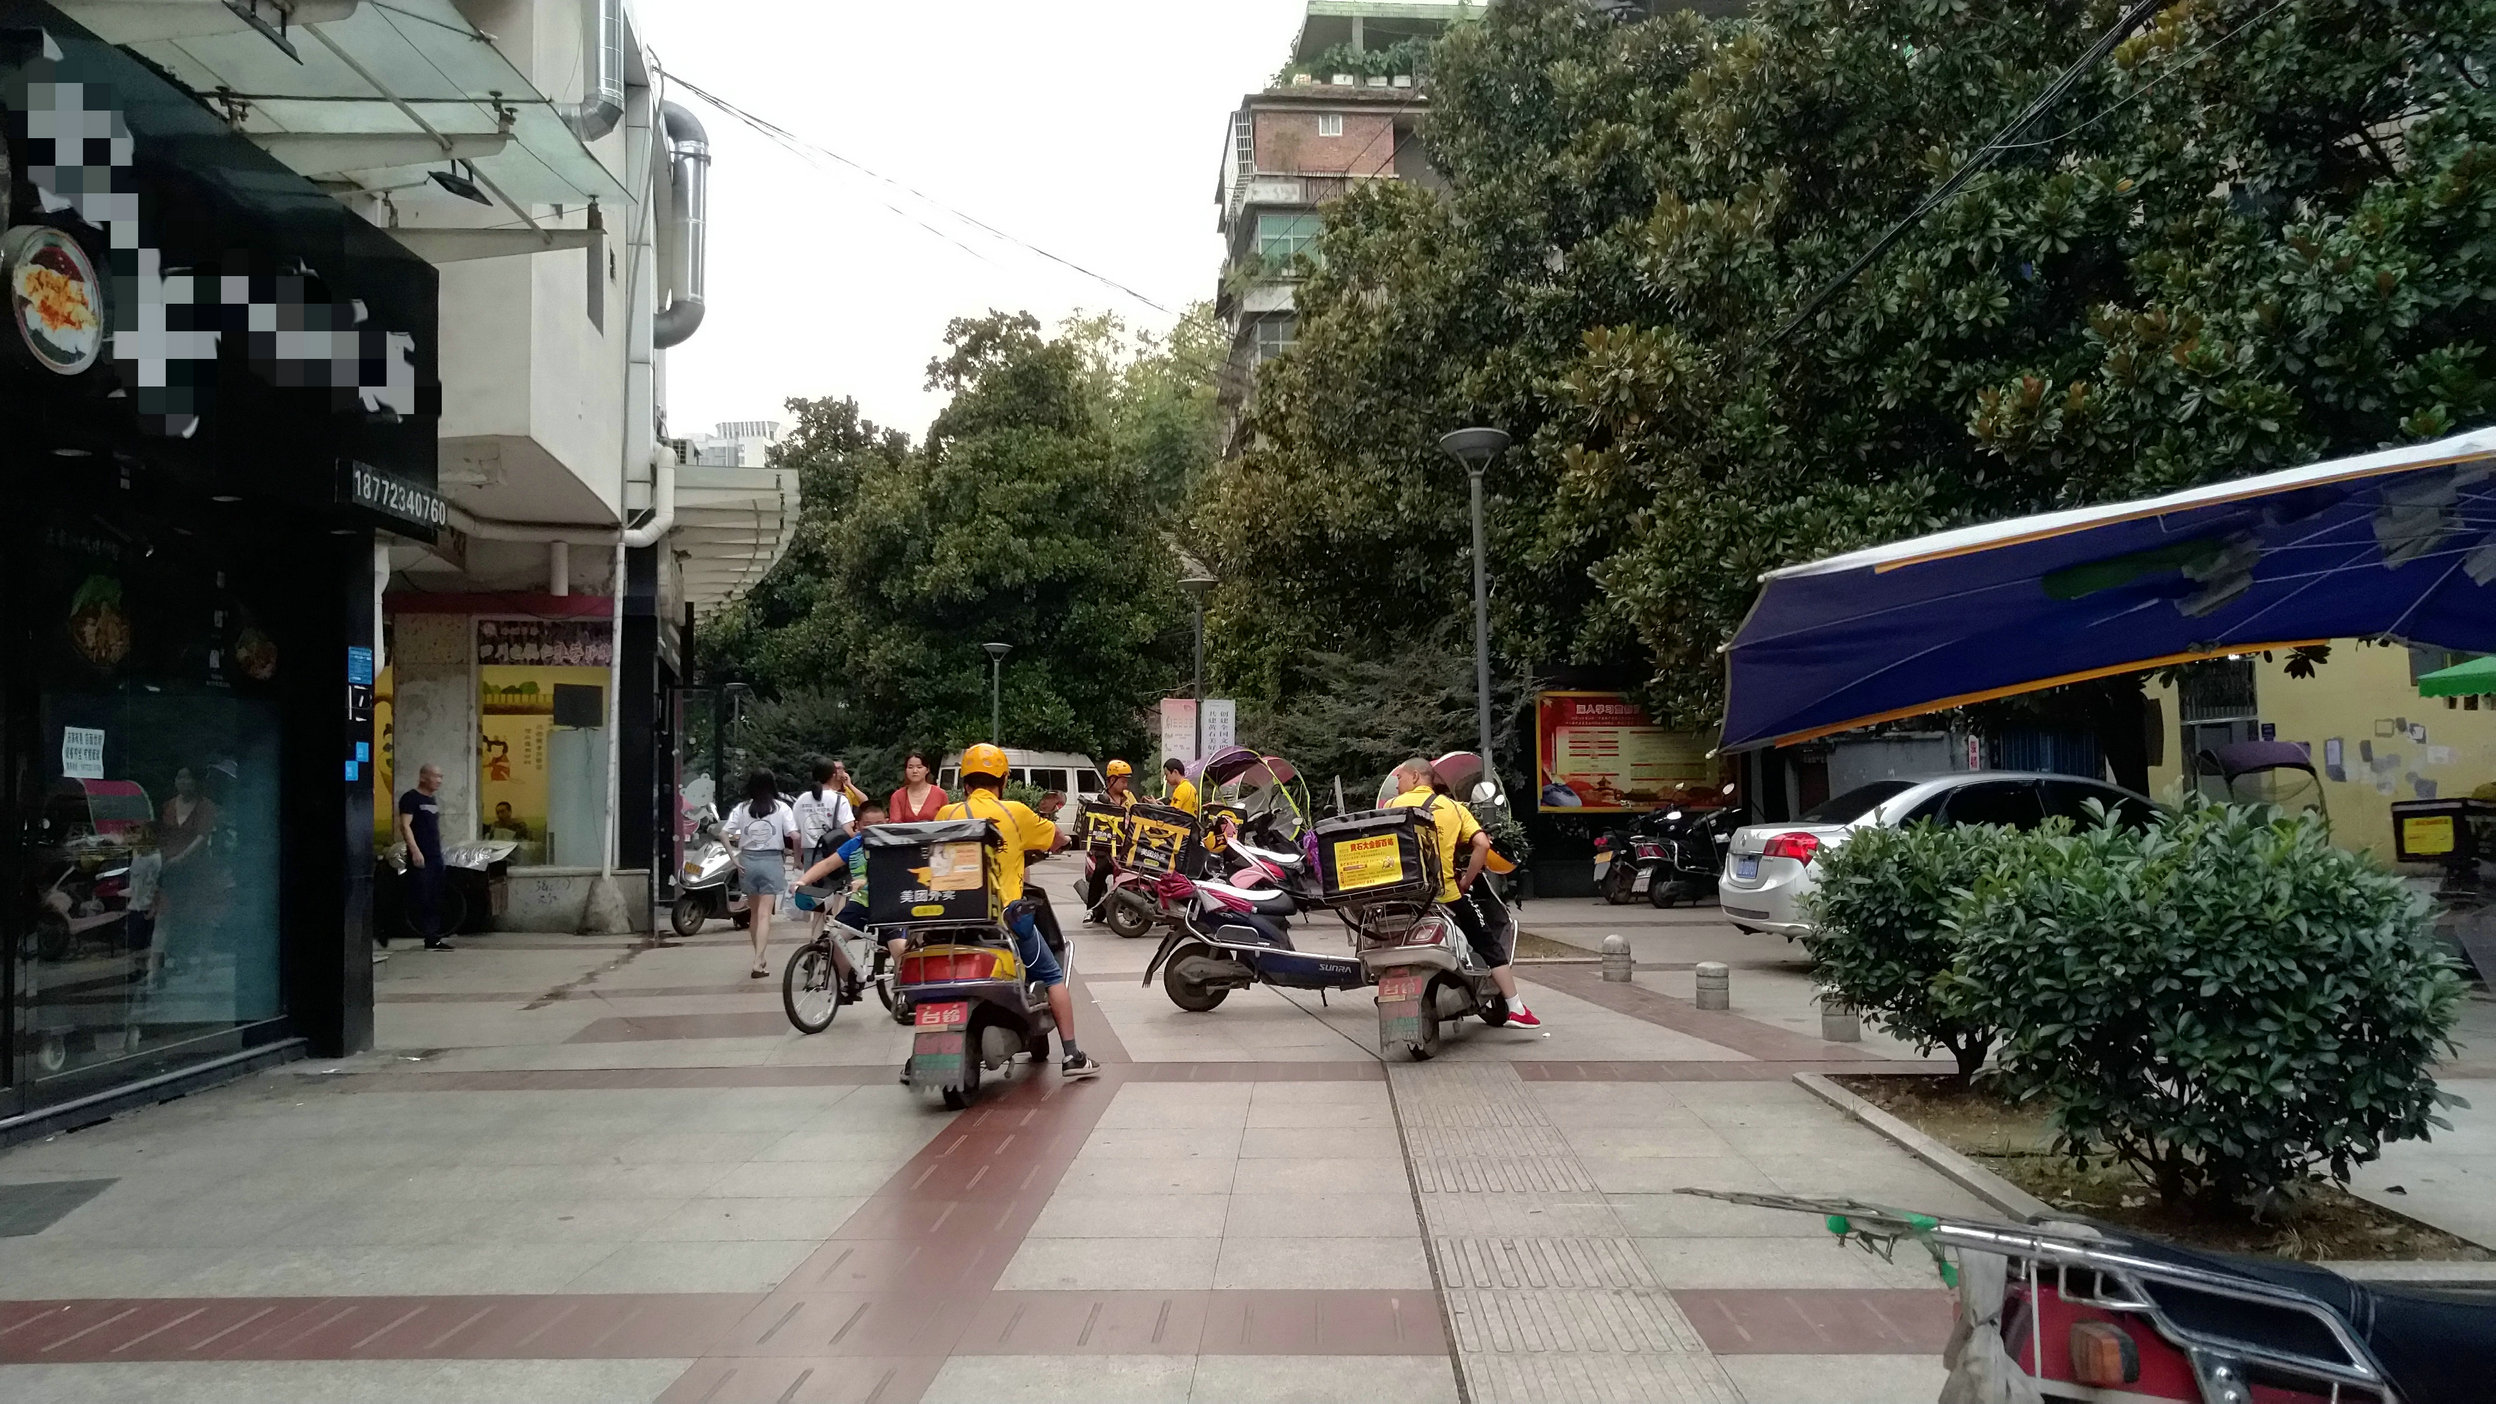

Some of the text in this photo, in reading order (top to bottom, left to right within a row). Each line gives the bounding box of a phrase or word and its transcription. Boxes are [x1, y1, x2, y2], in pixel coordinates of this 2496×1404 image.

[355, 470, 446, 526] 18772340760
[900, 889, 956, 904] 美团外卖
[1319, 963, 1352, 973] SUNRA
